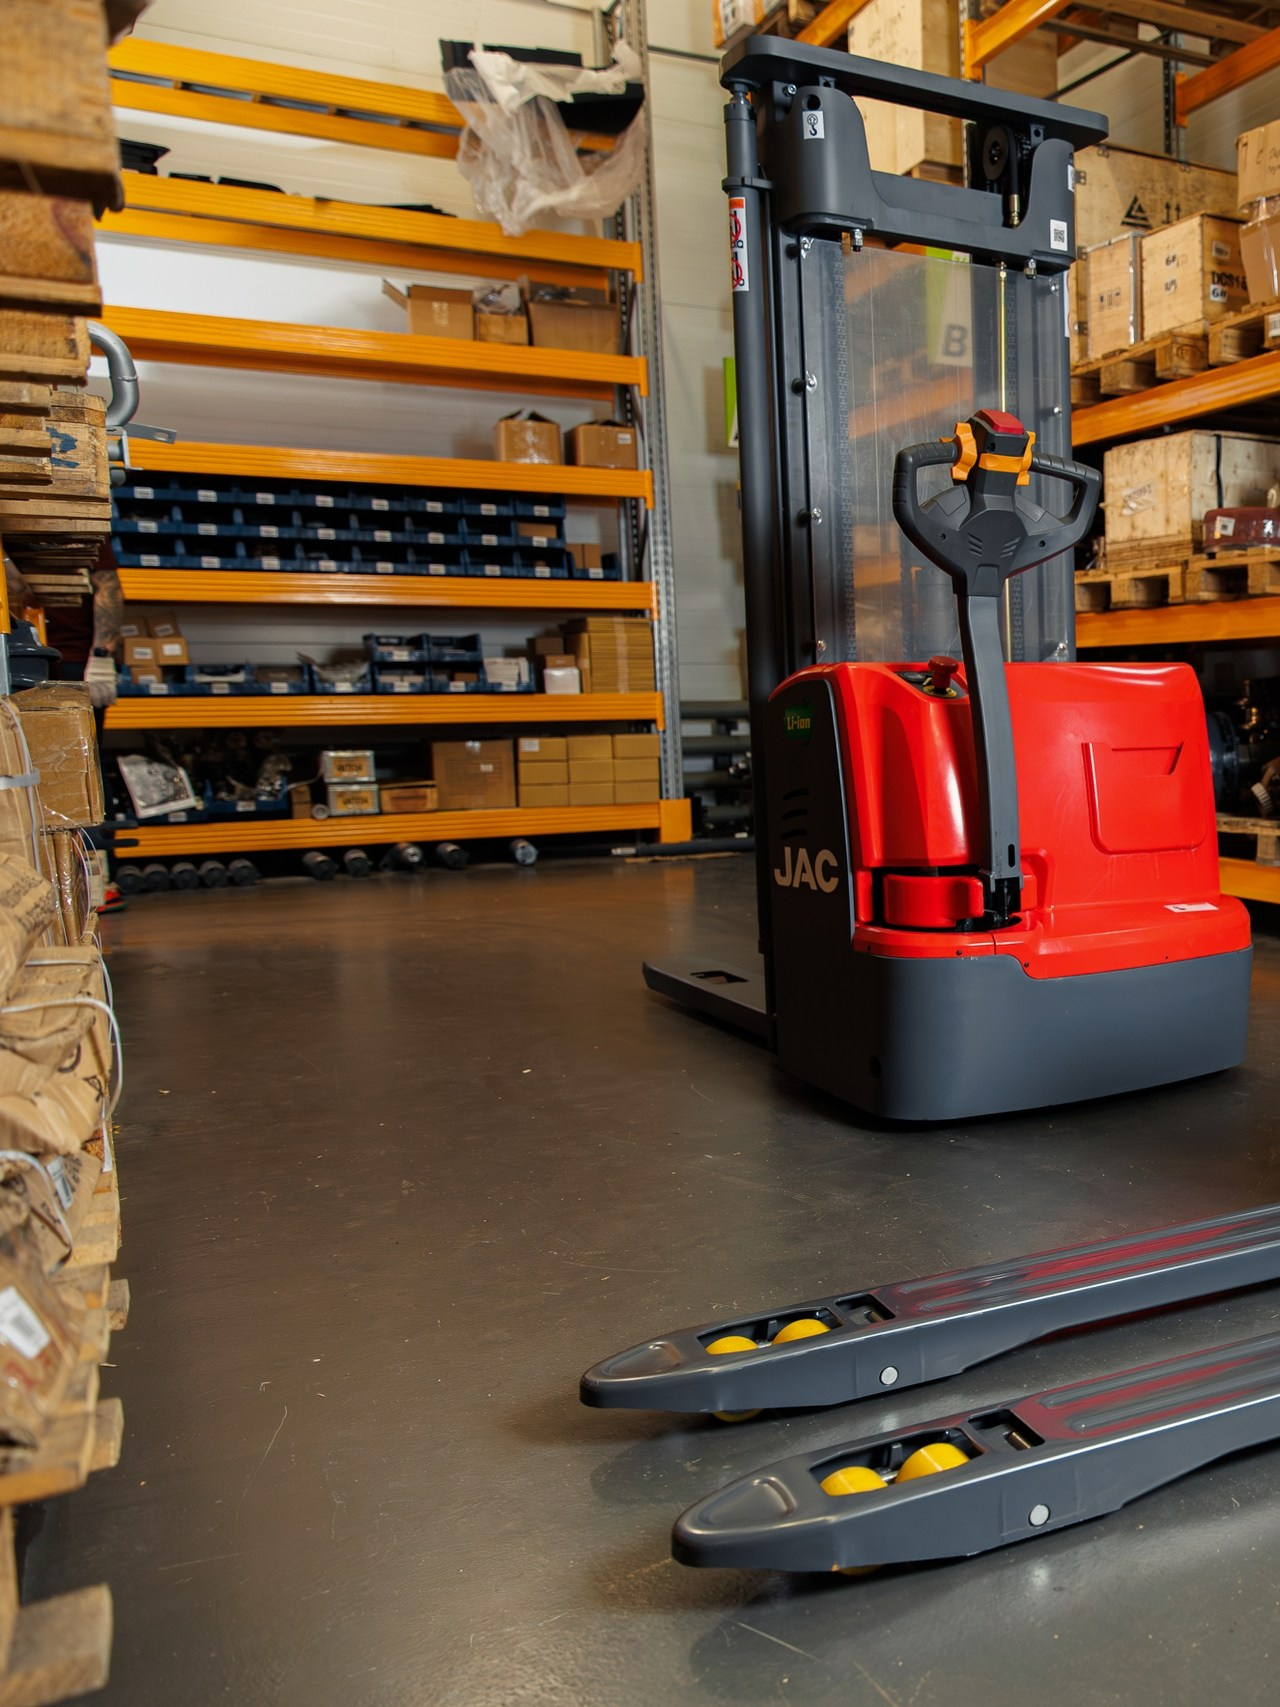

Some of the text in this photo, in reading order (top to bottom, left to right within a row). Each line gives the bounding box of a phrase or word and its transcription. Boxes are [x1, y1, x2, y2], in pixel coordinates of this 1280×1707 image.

[942, 324, 968, 358] B
[786, 715, 811, 731] Li-ion
[773, 846, 839, 893] JAC
